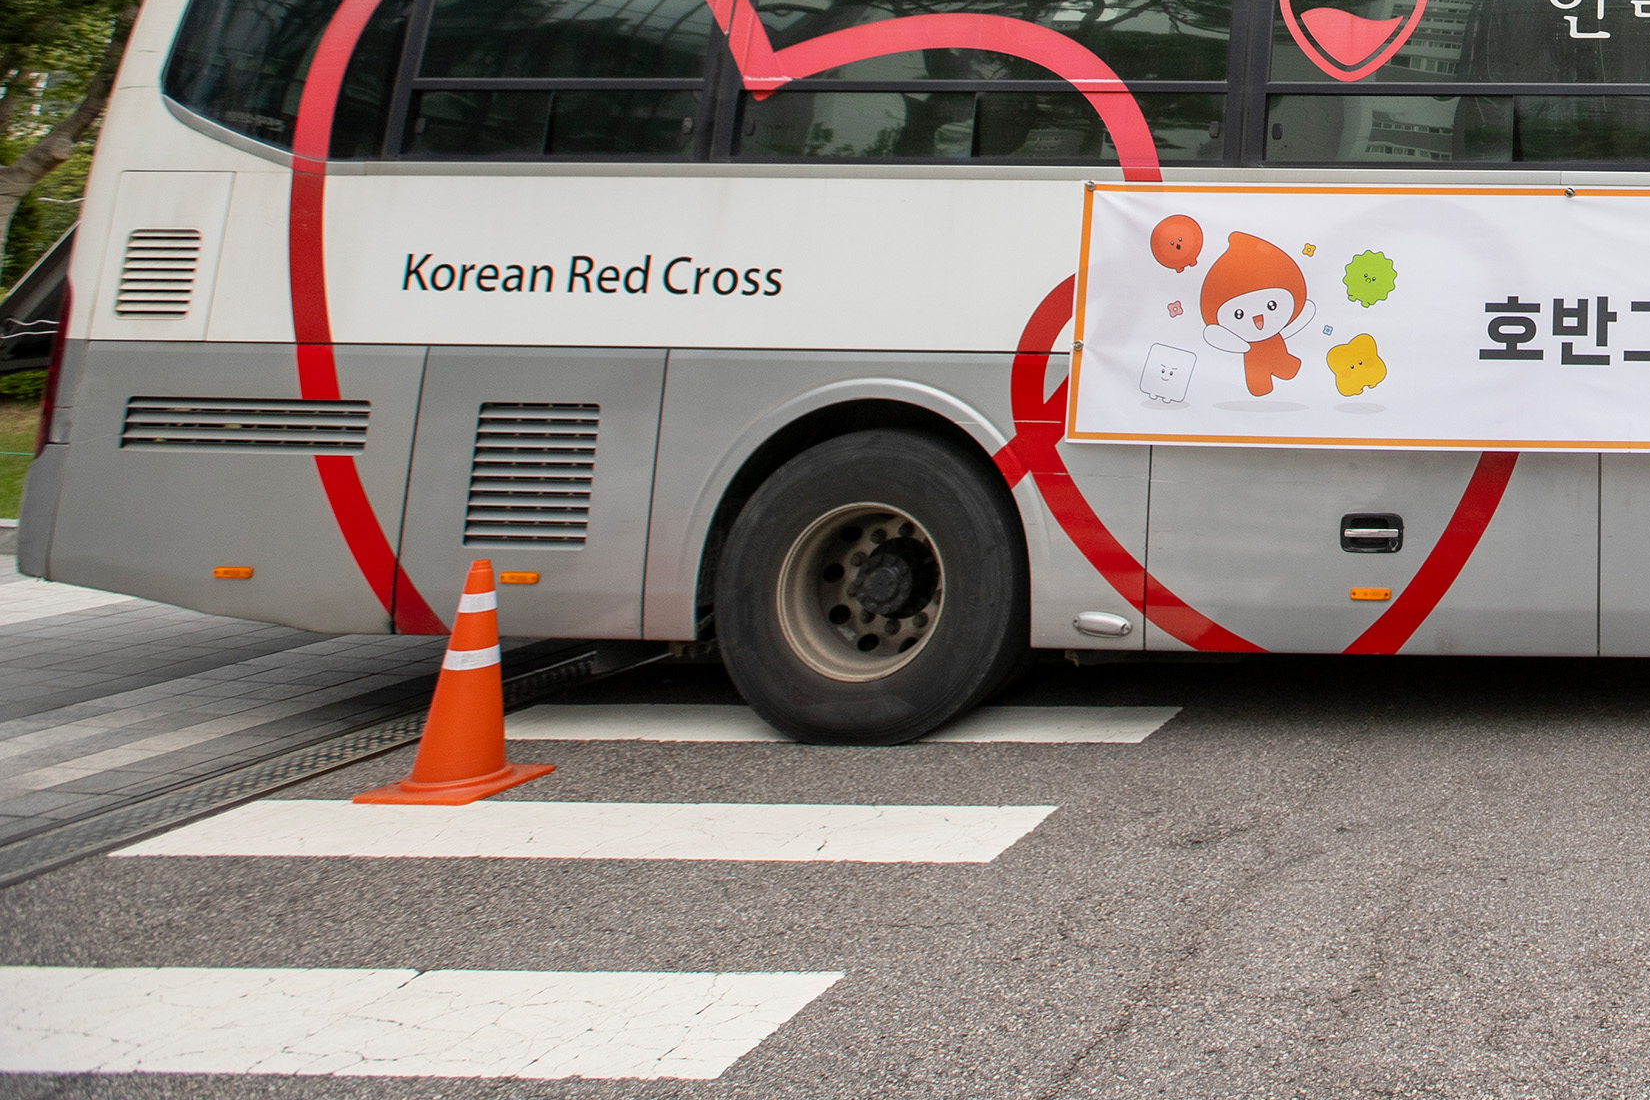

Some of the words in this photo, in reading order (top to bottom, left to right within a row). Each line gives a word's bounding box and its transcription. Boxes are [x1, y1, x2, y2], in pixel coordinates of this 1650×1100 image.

[403, 254, 553, 292] Korean
[568, 255, 651, 293] Red
[664, 257, 782, 296] Cross
